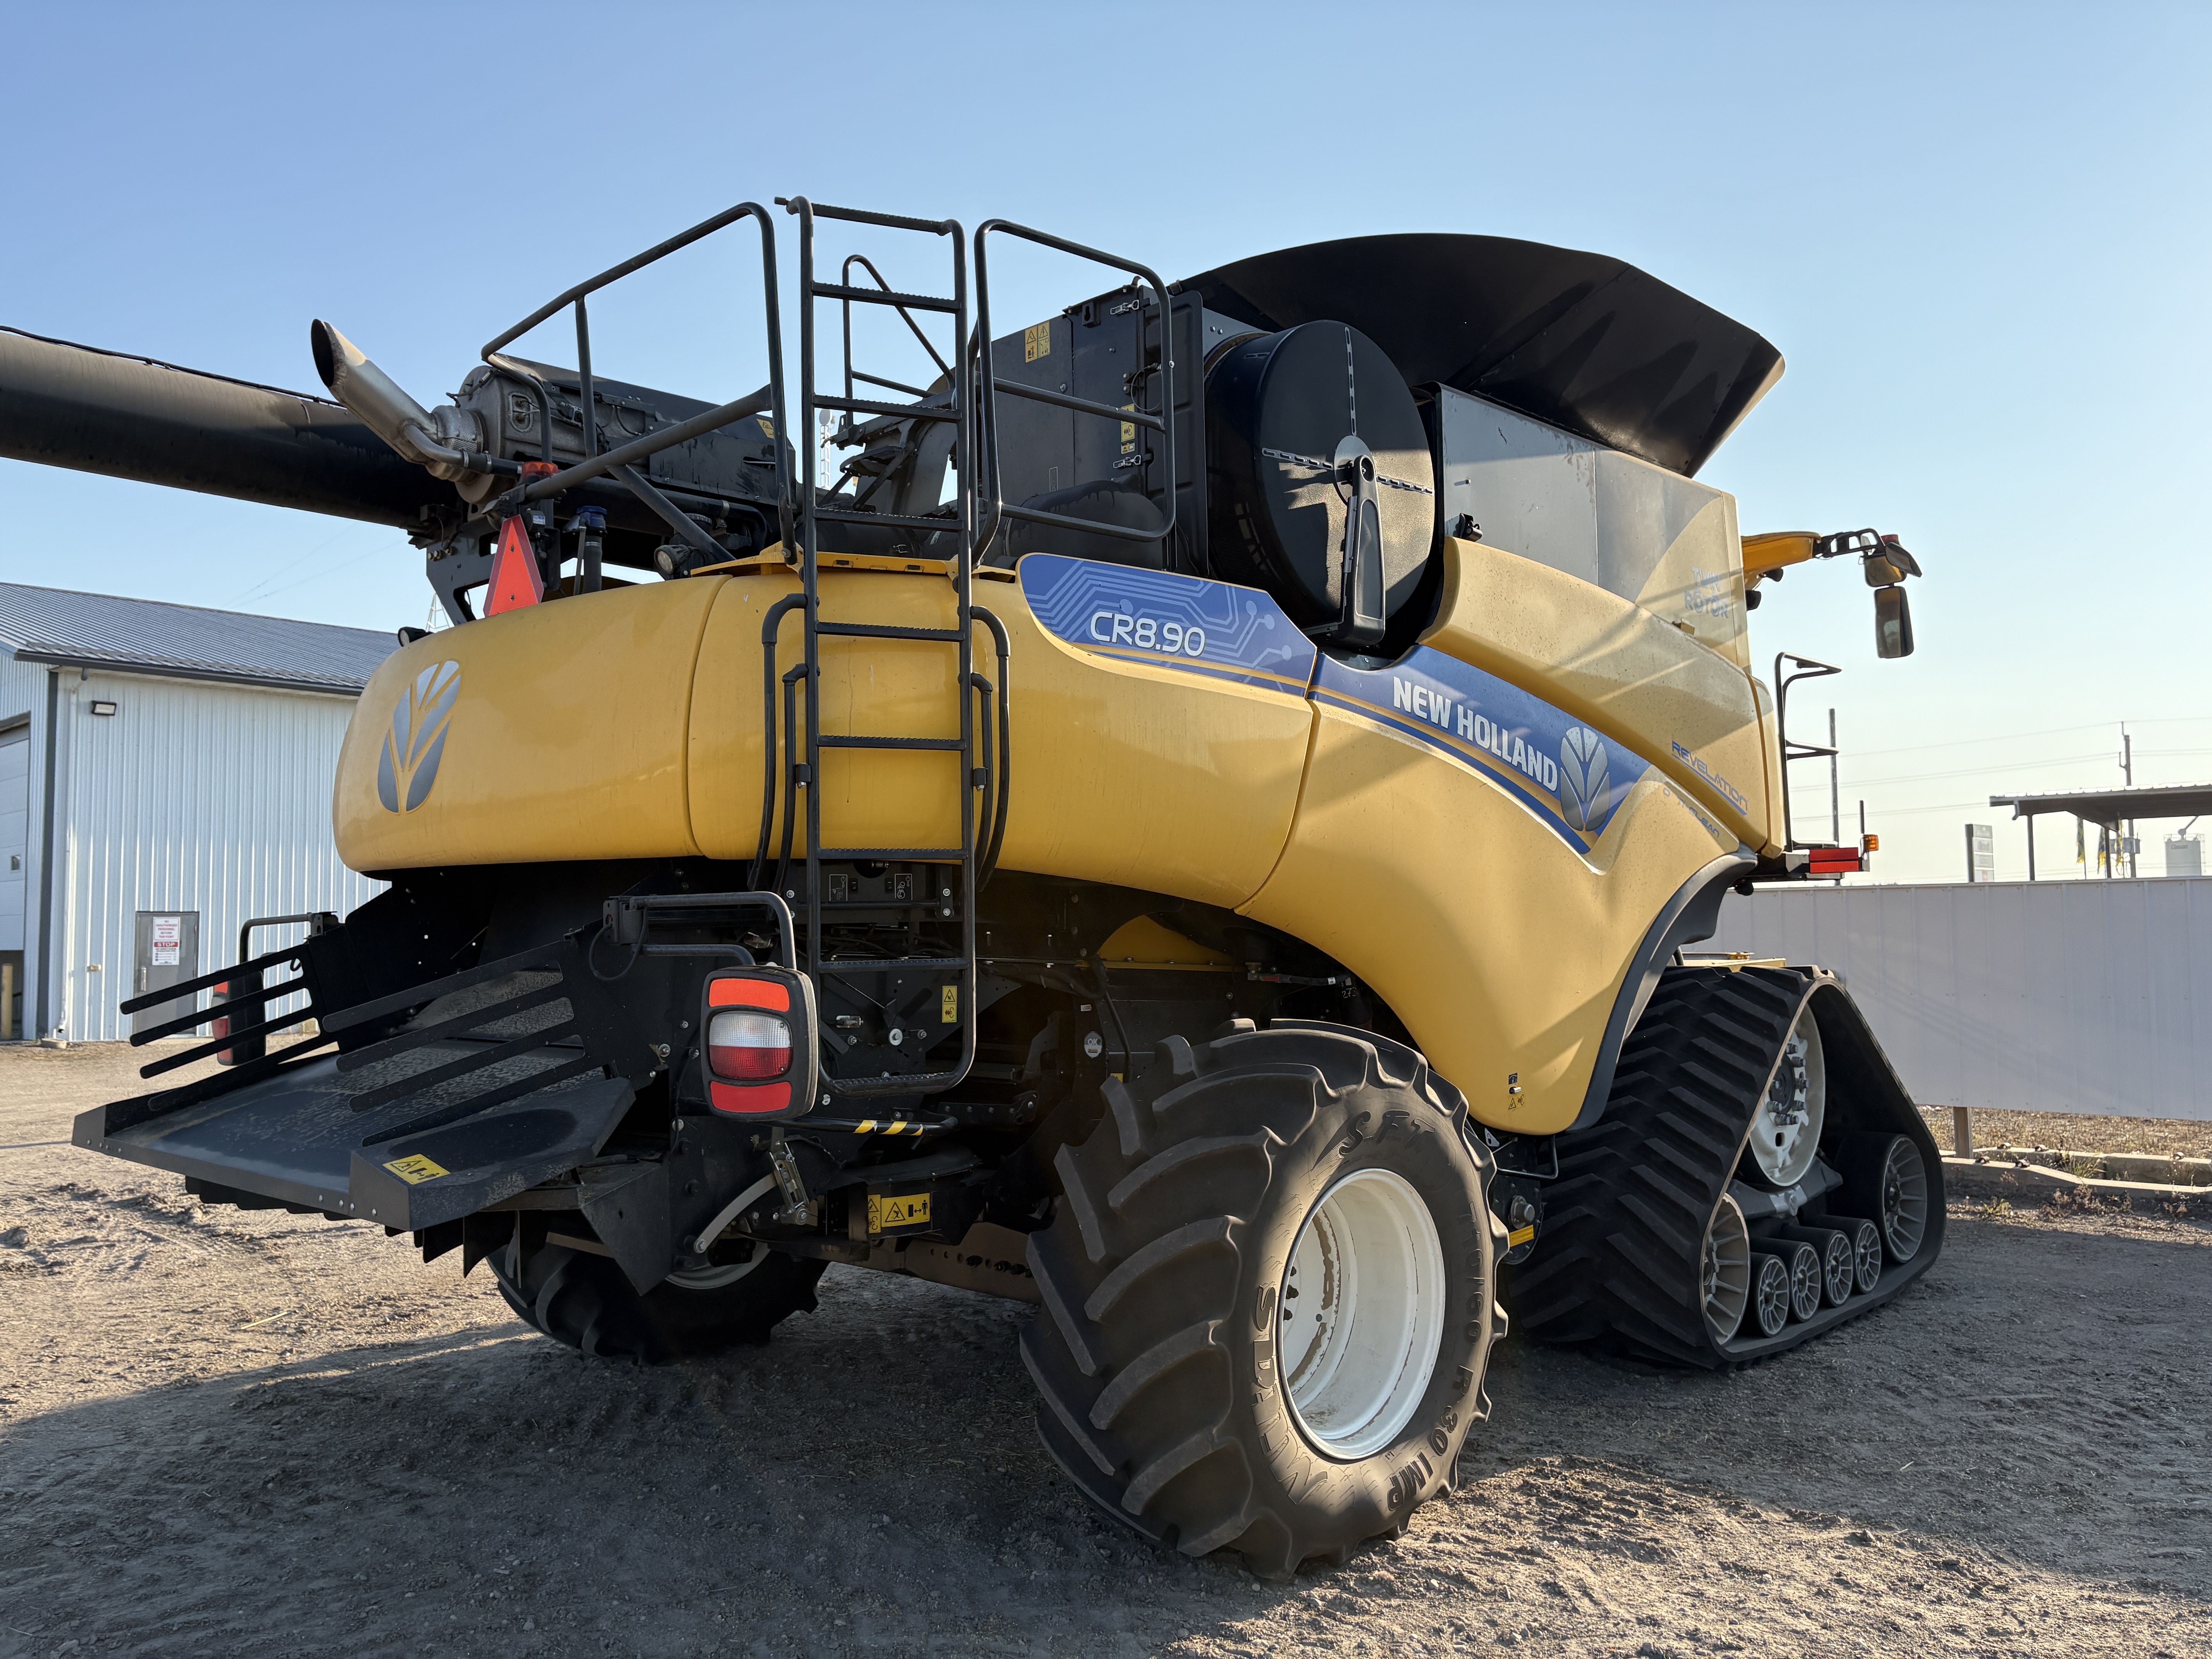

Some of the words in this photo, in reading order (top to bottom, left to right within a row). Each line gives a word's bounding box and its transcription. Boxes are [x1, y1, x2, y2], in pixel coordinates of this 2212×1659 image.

[1685, 587, 1729, 618] ROTOR
[1691, 567, 1722, 592] TWIN
[1091, 611, 1205, 656] CR8.90
[1393, 676, 1451, 729] NEW
[1457, 704, 1558, 792] HOLLAND
[1672, 740, 1748, 812] REVELATION
[1427, 1405, 1458, 1456] 30
[1387, 1452, 1434, 1511] IMP
